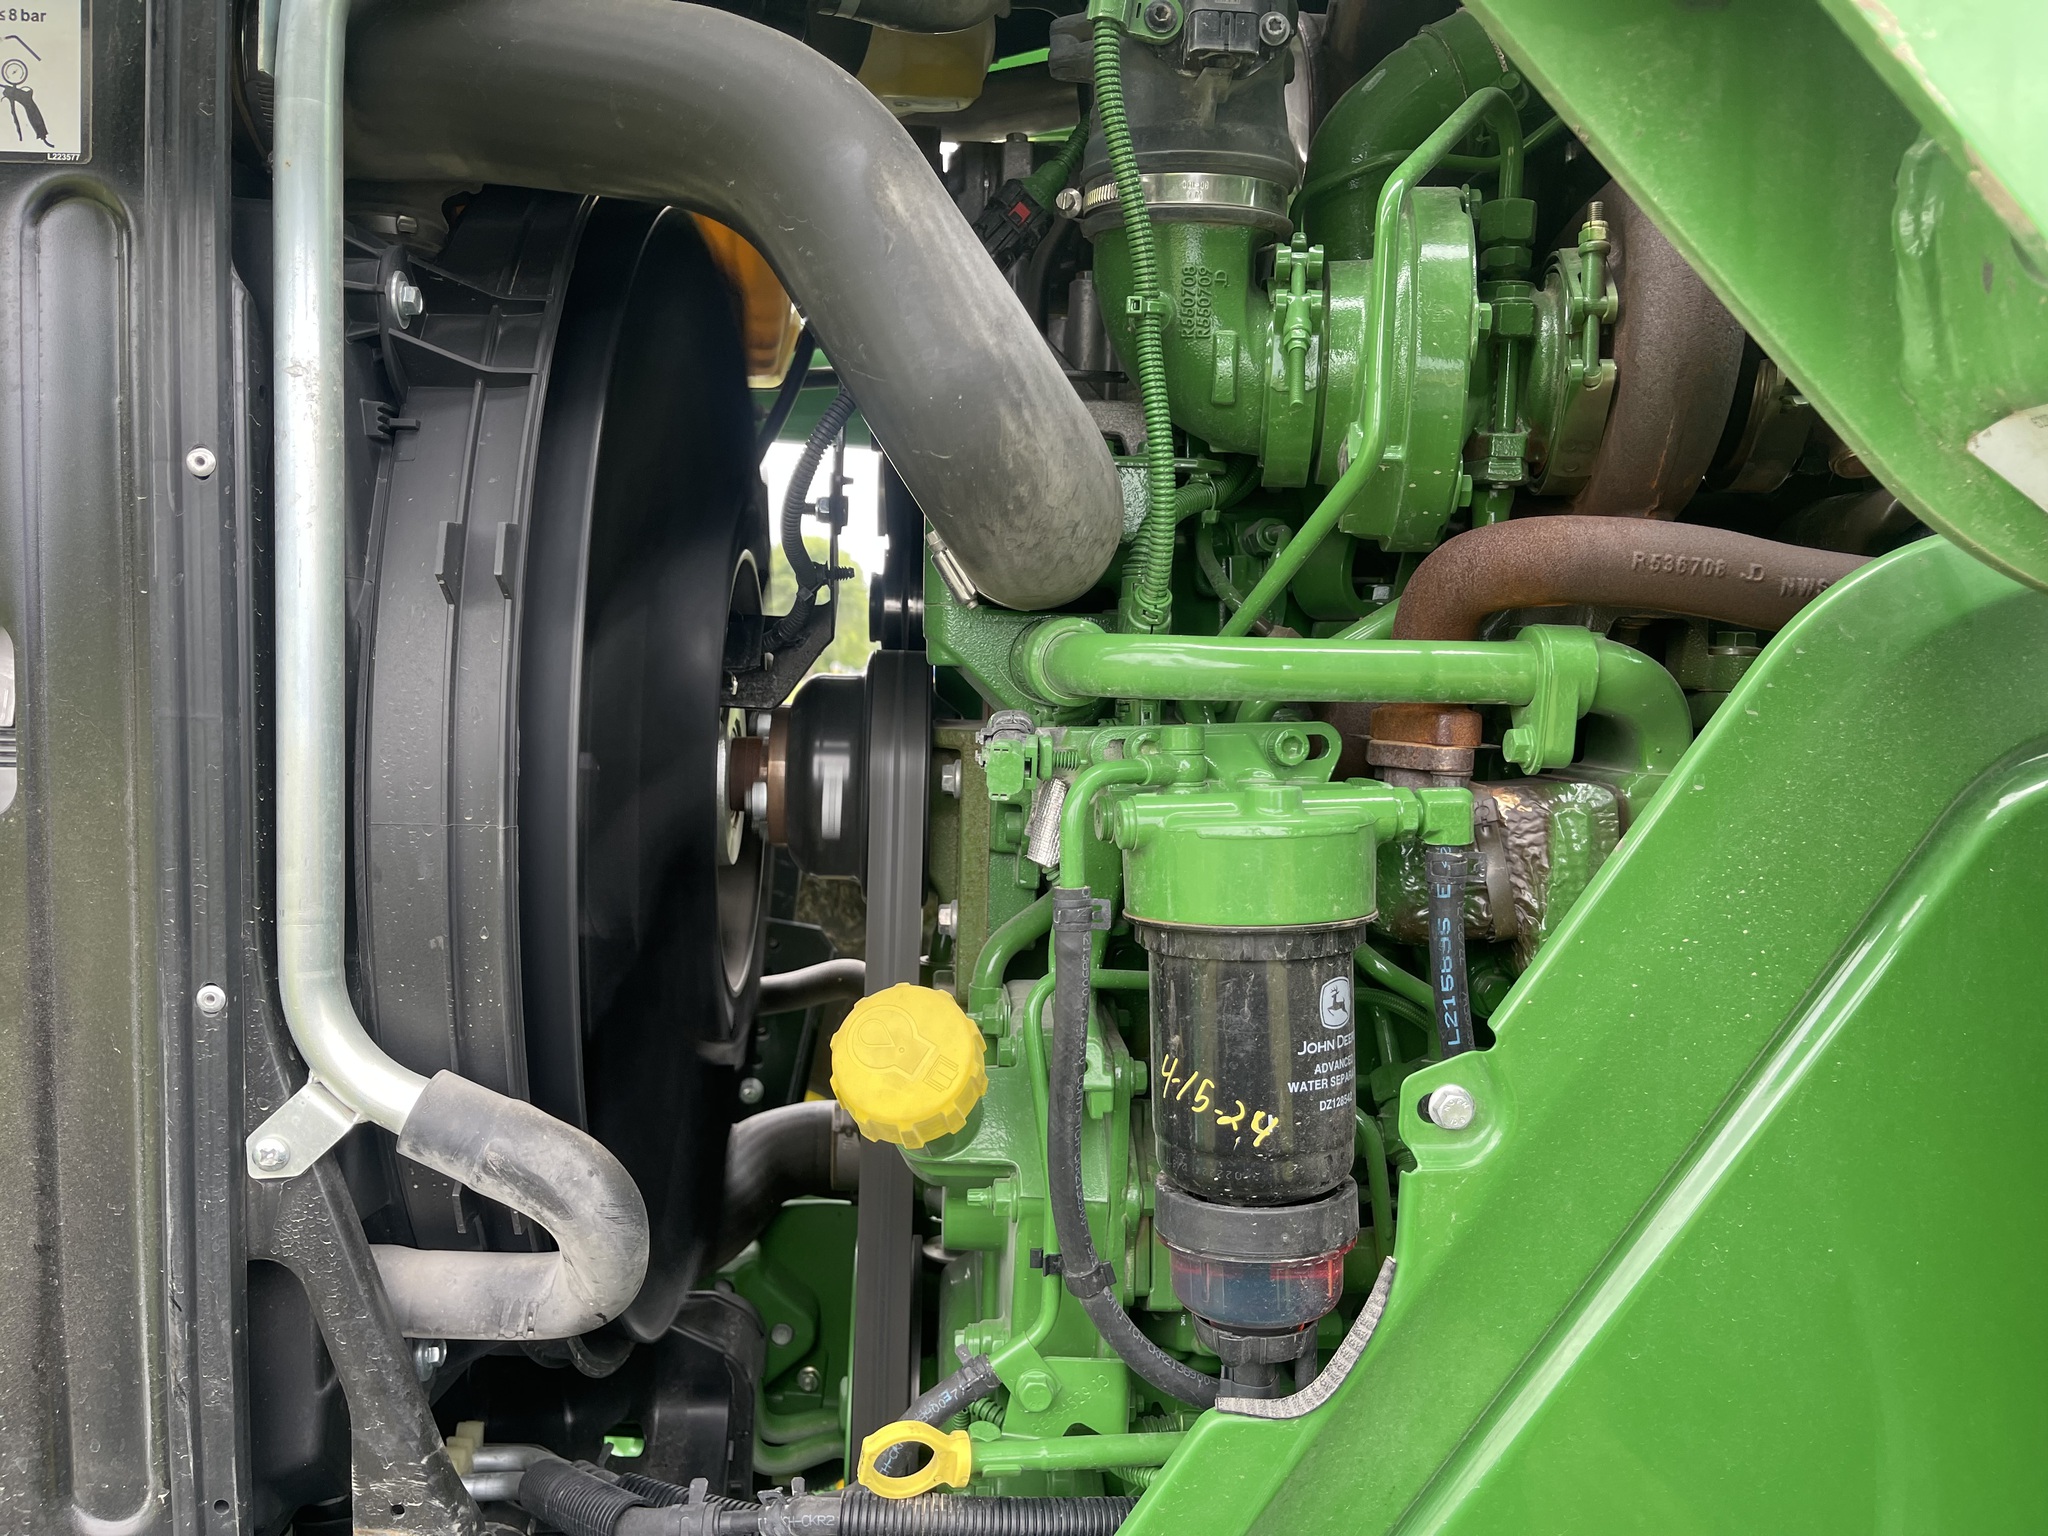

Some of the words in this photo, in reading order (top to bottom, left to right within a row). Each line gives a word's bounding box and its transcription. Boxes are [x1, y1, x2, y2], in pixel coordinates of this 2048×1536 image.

[20, 8, 47, 22] bar
[47, 152, 80, 161] L223577
[1180, 263, 1197, 339] R550708
[1196, 265, 1213, 339] R550709
[1297, 1039, 1335, 1056] JOHN
[1287, 1078, 1329, 1094] WATER
